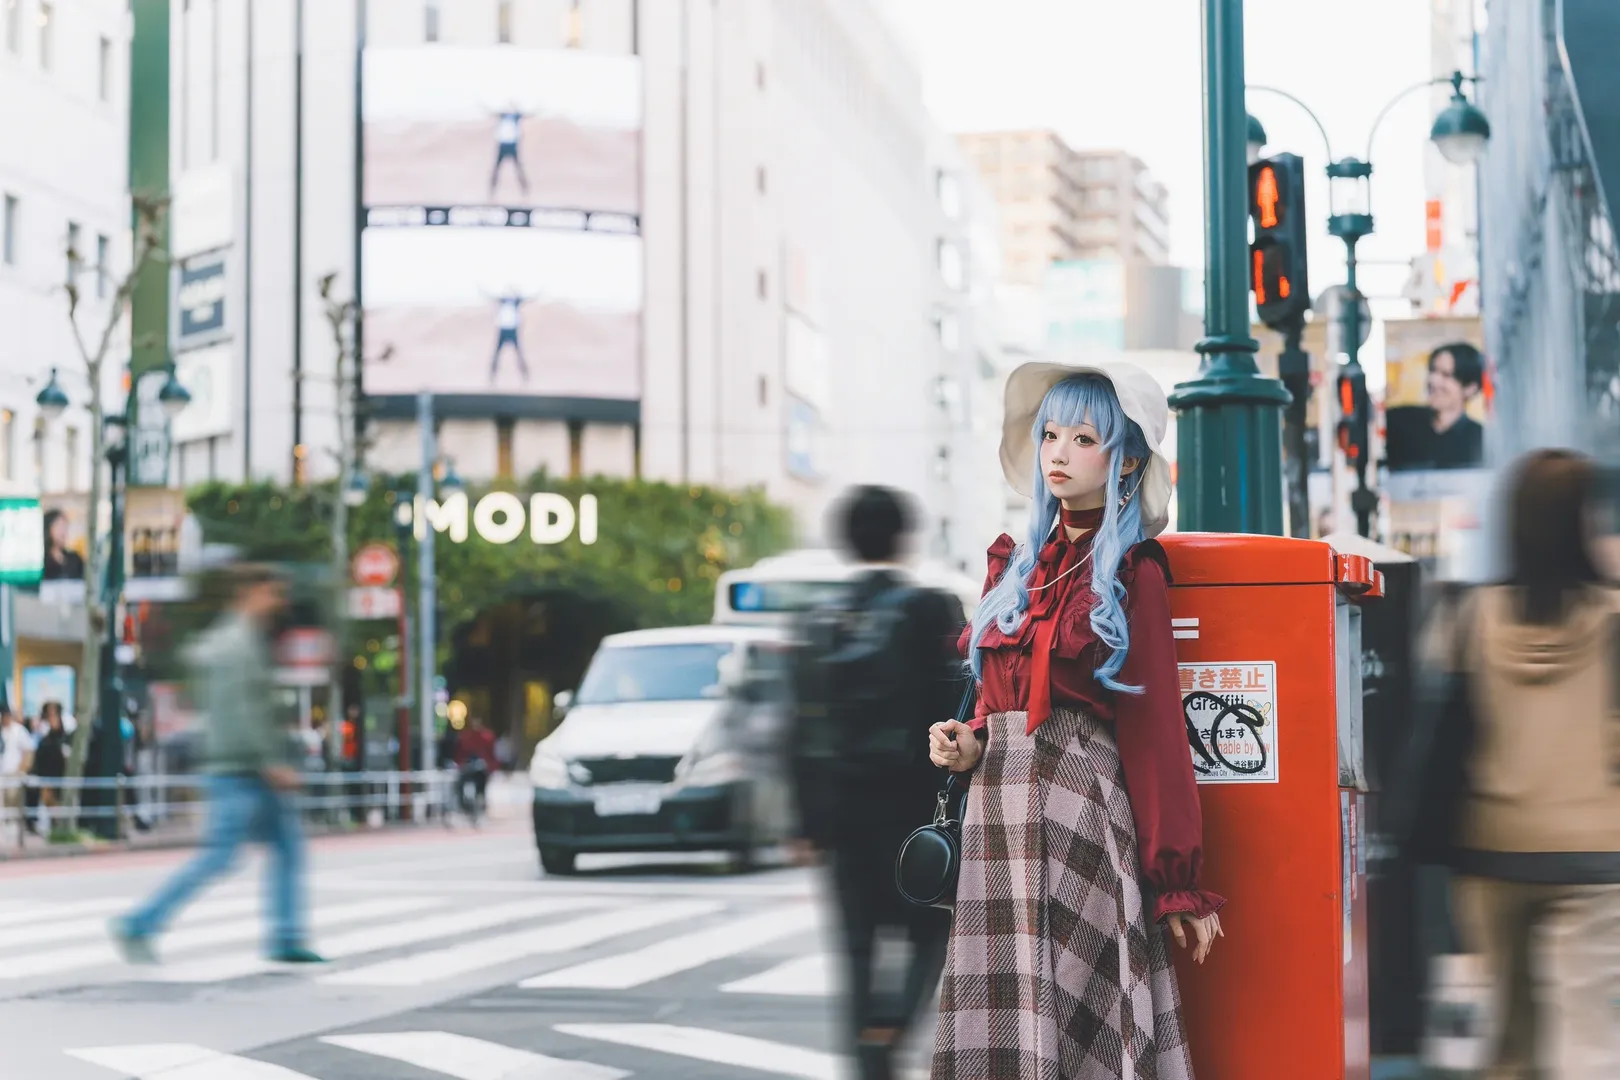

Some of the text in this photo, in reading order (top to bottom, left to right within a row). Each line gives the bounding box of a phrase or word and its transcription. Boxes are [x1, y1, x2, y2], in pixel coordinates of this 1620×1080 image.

[413, 491, 598, 546] MODI
[1196, 727, 1245, 739] されます
[1244, 740, 1254, 755] by
